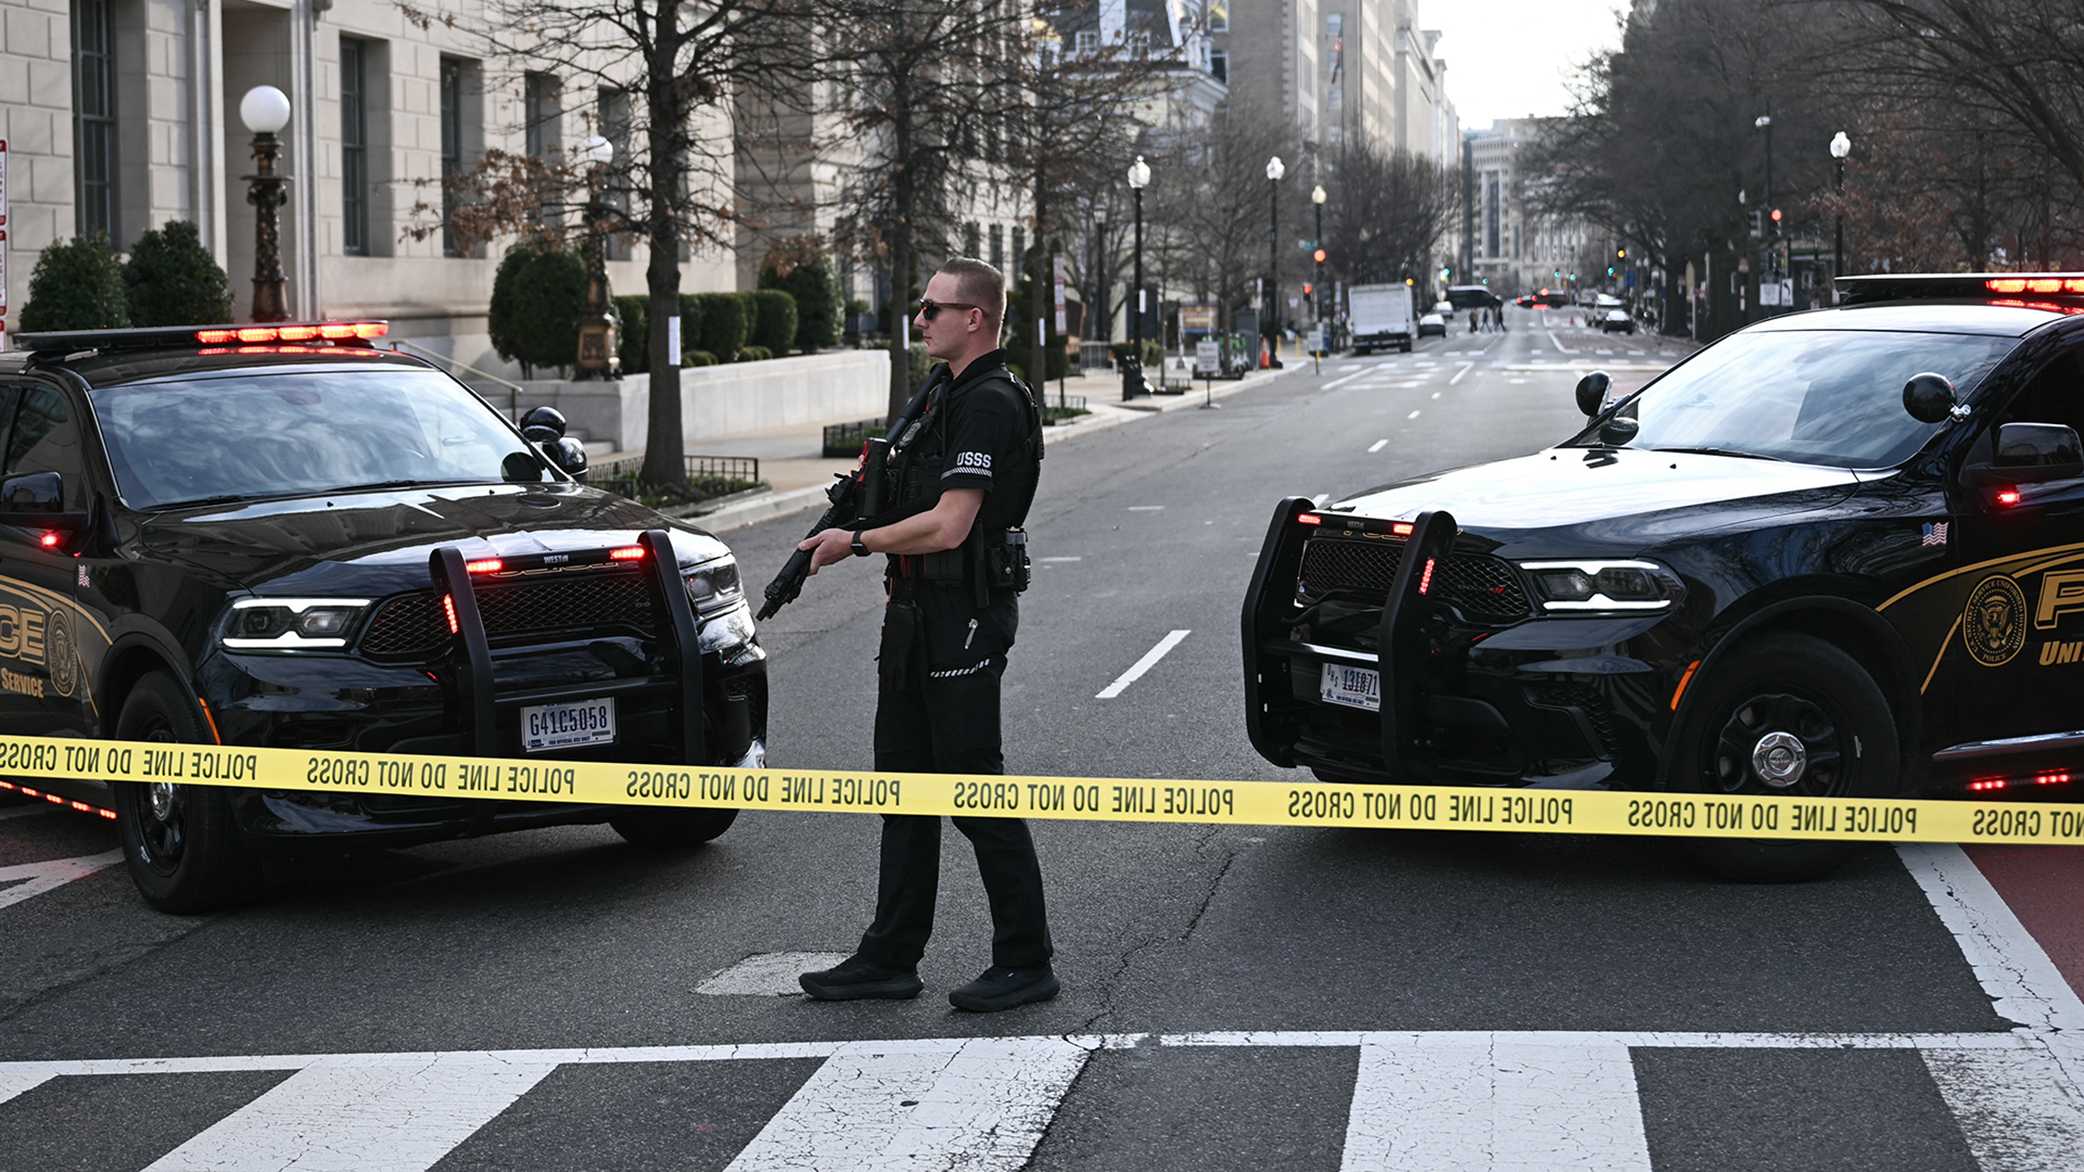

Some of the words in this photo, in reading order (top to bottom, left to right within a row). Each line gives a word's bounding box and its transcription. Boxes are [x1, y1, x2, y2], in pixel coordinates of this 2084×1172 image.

[957, 452, 992, 468] USSS
[2039, 640, 2084, 667] UNI
[1, 667, 45, 699] SERVICE
[530, 705, 608, 737] G41C5058
